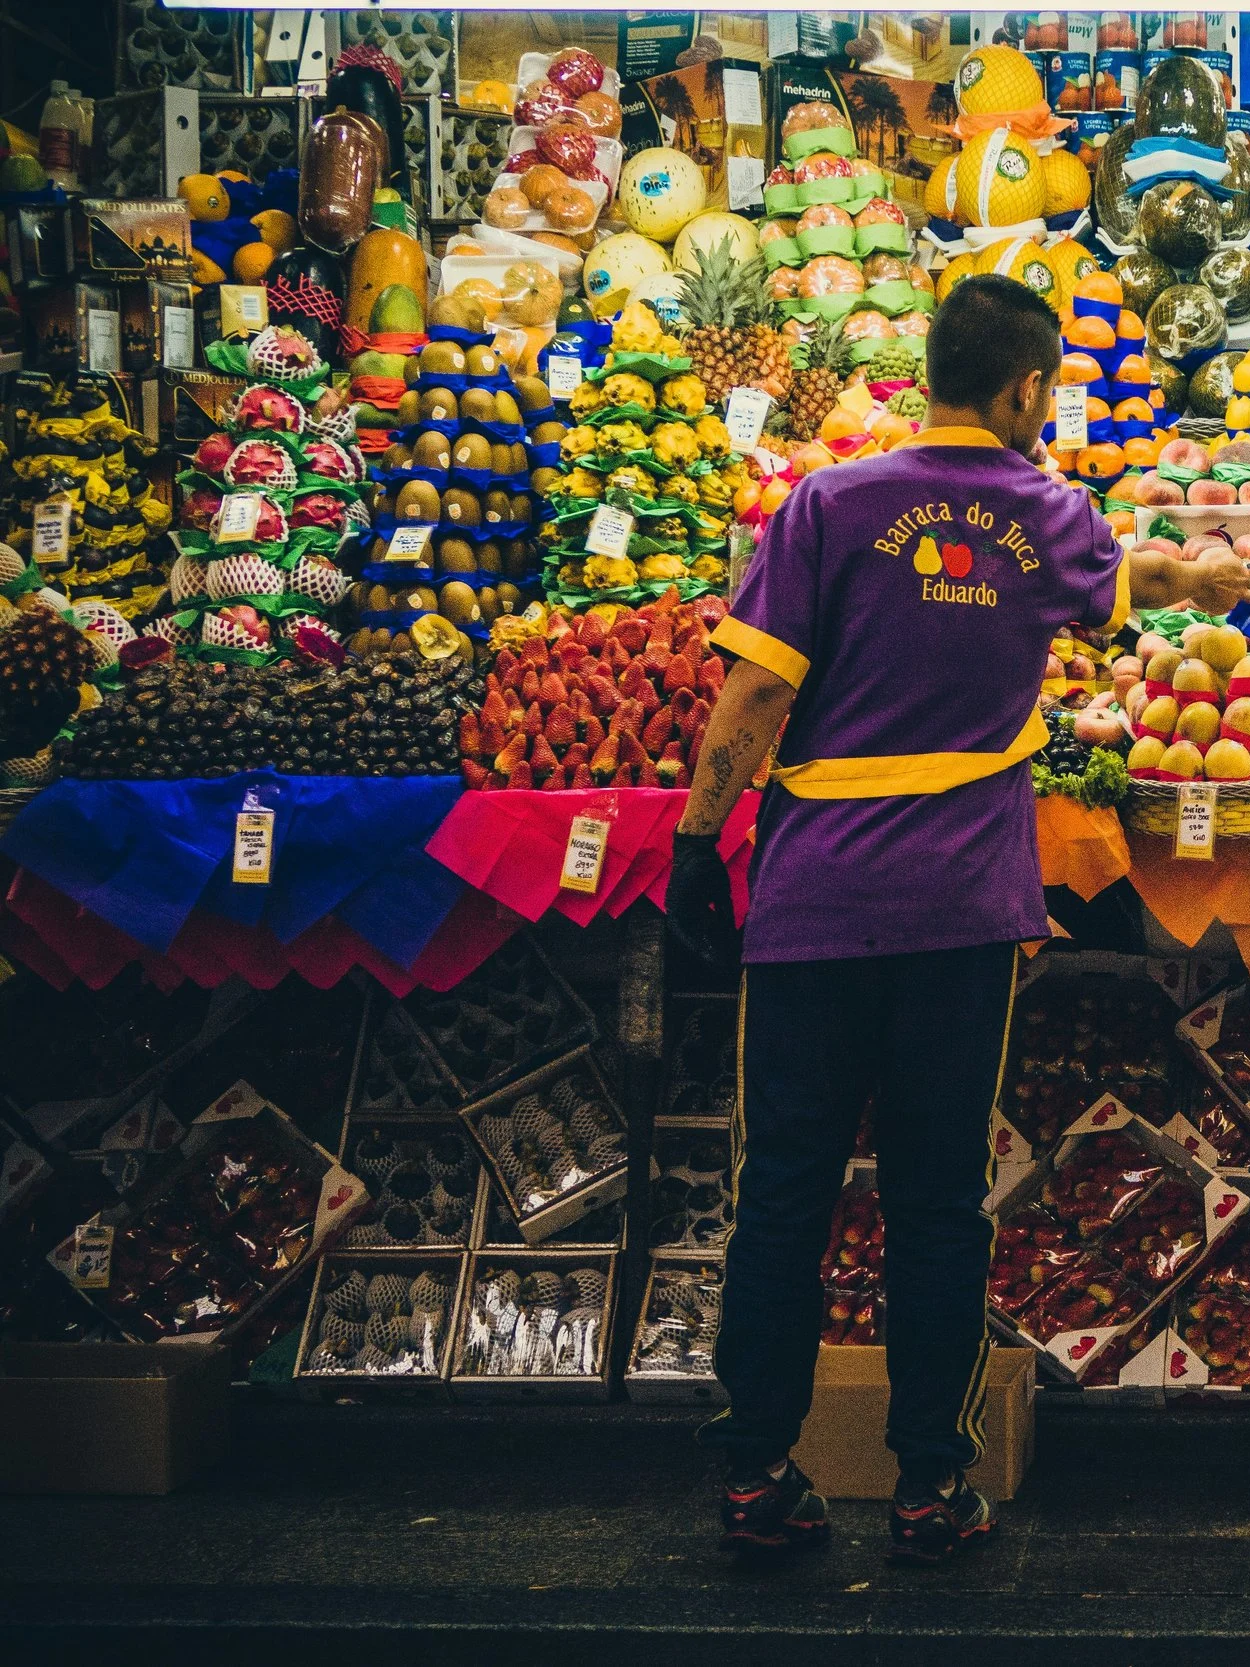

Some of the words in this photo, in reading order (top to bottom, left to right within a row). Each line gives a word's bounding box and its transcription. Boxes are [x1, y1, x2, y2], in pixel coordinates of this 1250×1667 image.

[783, 85, 831, 99] mehadrin
[151, 203, 187, 214] DATES
[590, 277, 609, 292] Dino
[183, 373, 232, 386] MEDJOUL
[873, 502, 953, 557] Barraca
[966, 501, 994, 530] do
[996, 520, 1041, 574] Juca
[922, 577, 998, 607] Eduardo
[570, 838, 601, 853] MORANGO
